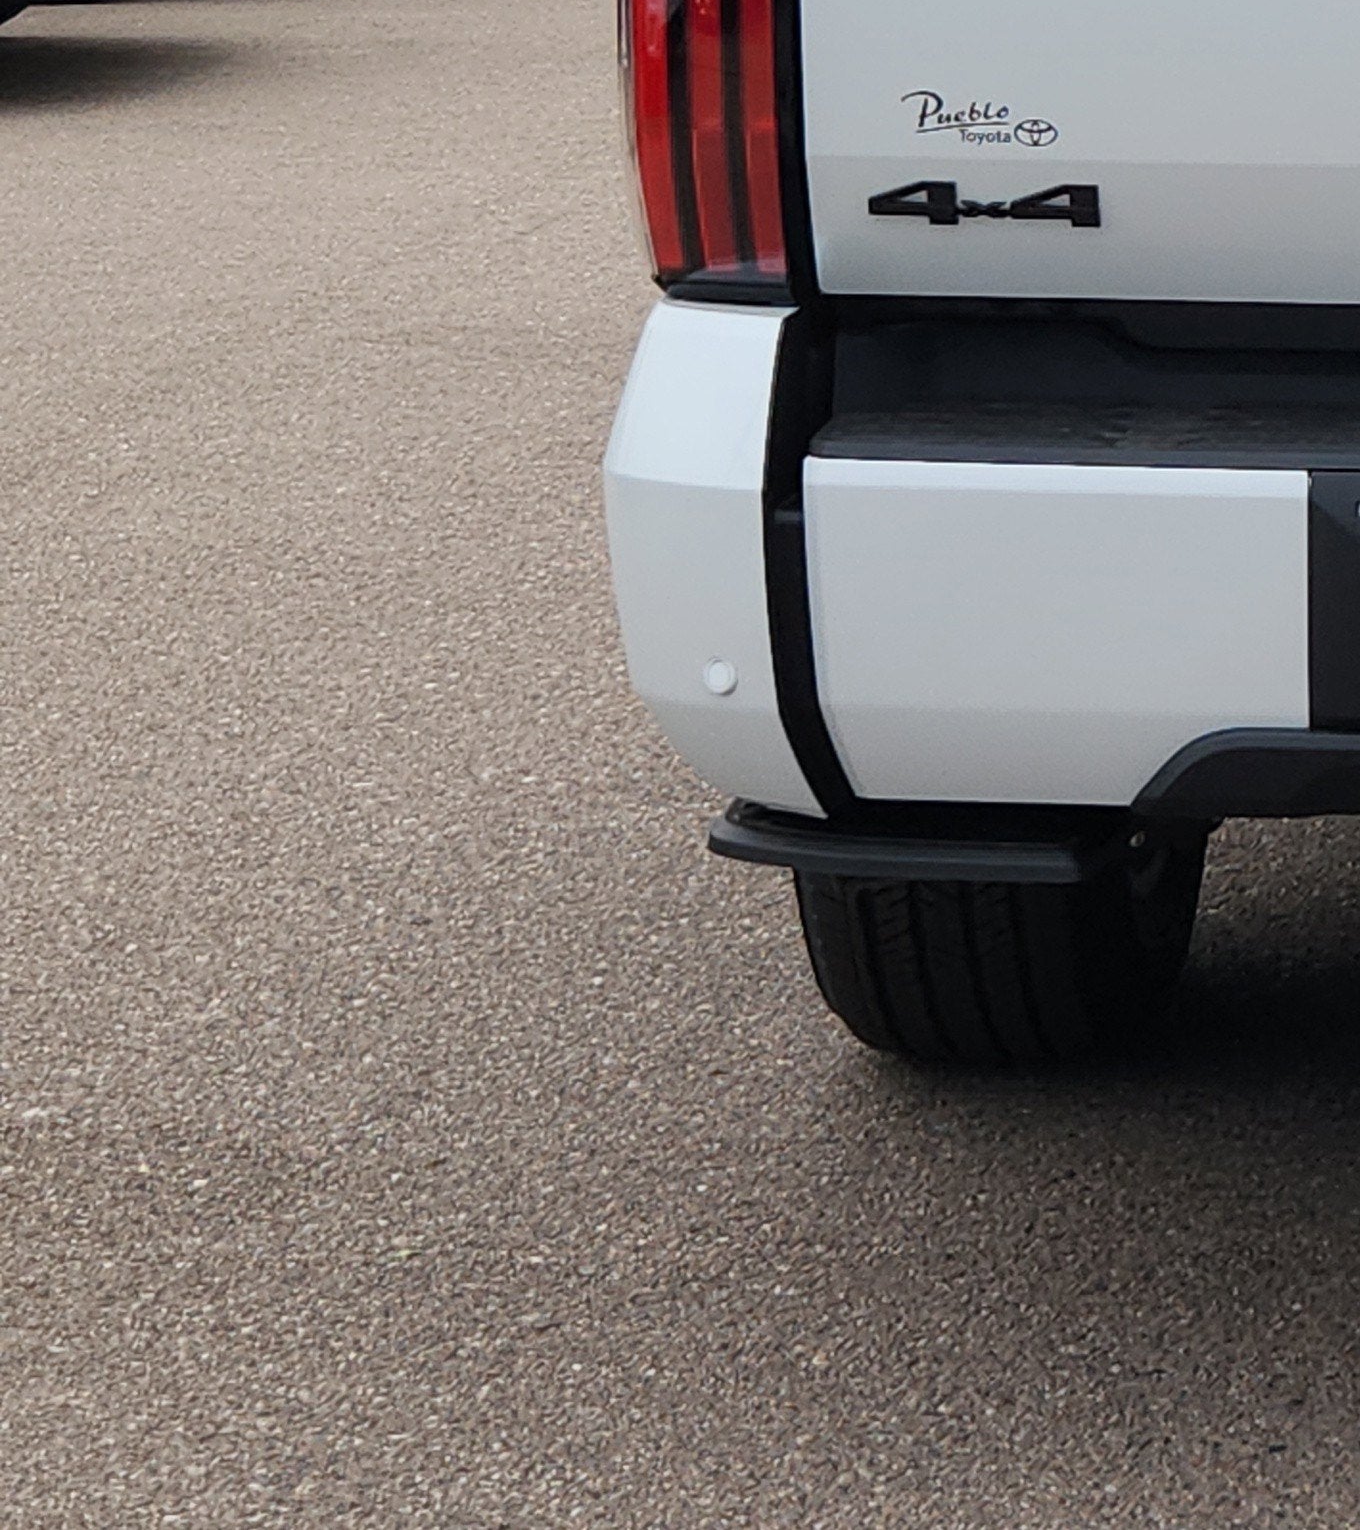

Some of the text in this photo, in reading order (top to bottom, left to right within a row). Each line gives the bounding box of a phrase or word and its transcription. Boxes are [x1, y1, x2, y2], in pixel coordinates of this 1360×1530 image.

[901, 90, 1010, 128] Pueblo
[958, 128, 1011, 146] Toyota
[868, 180, 1101, 228] 4x4
